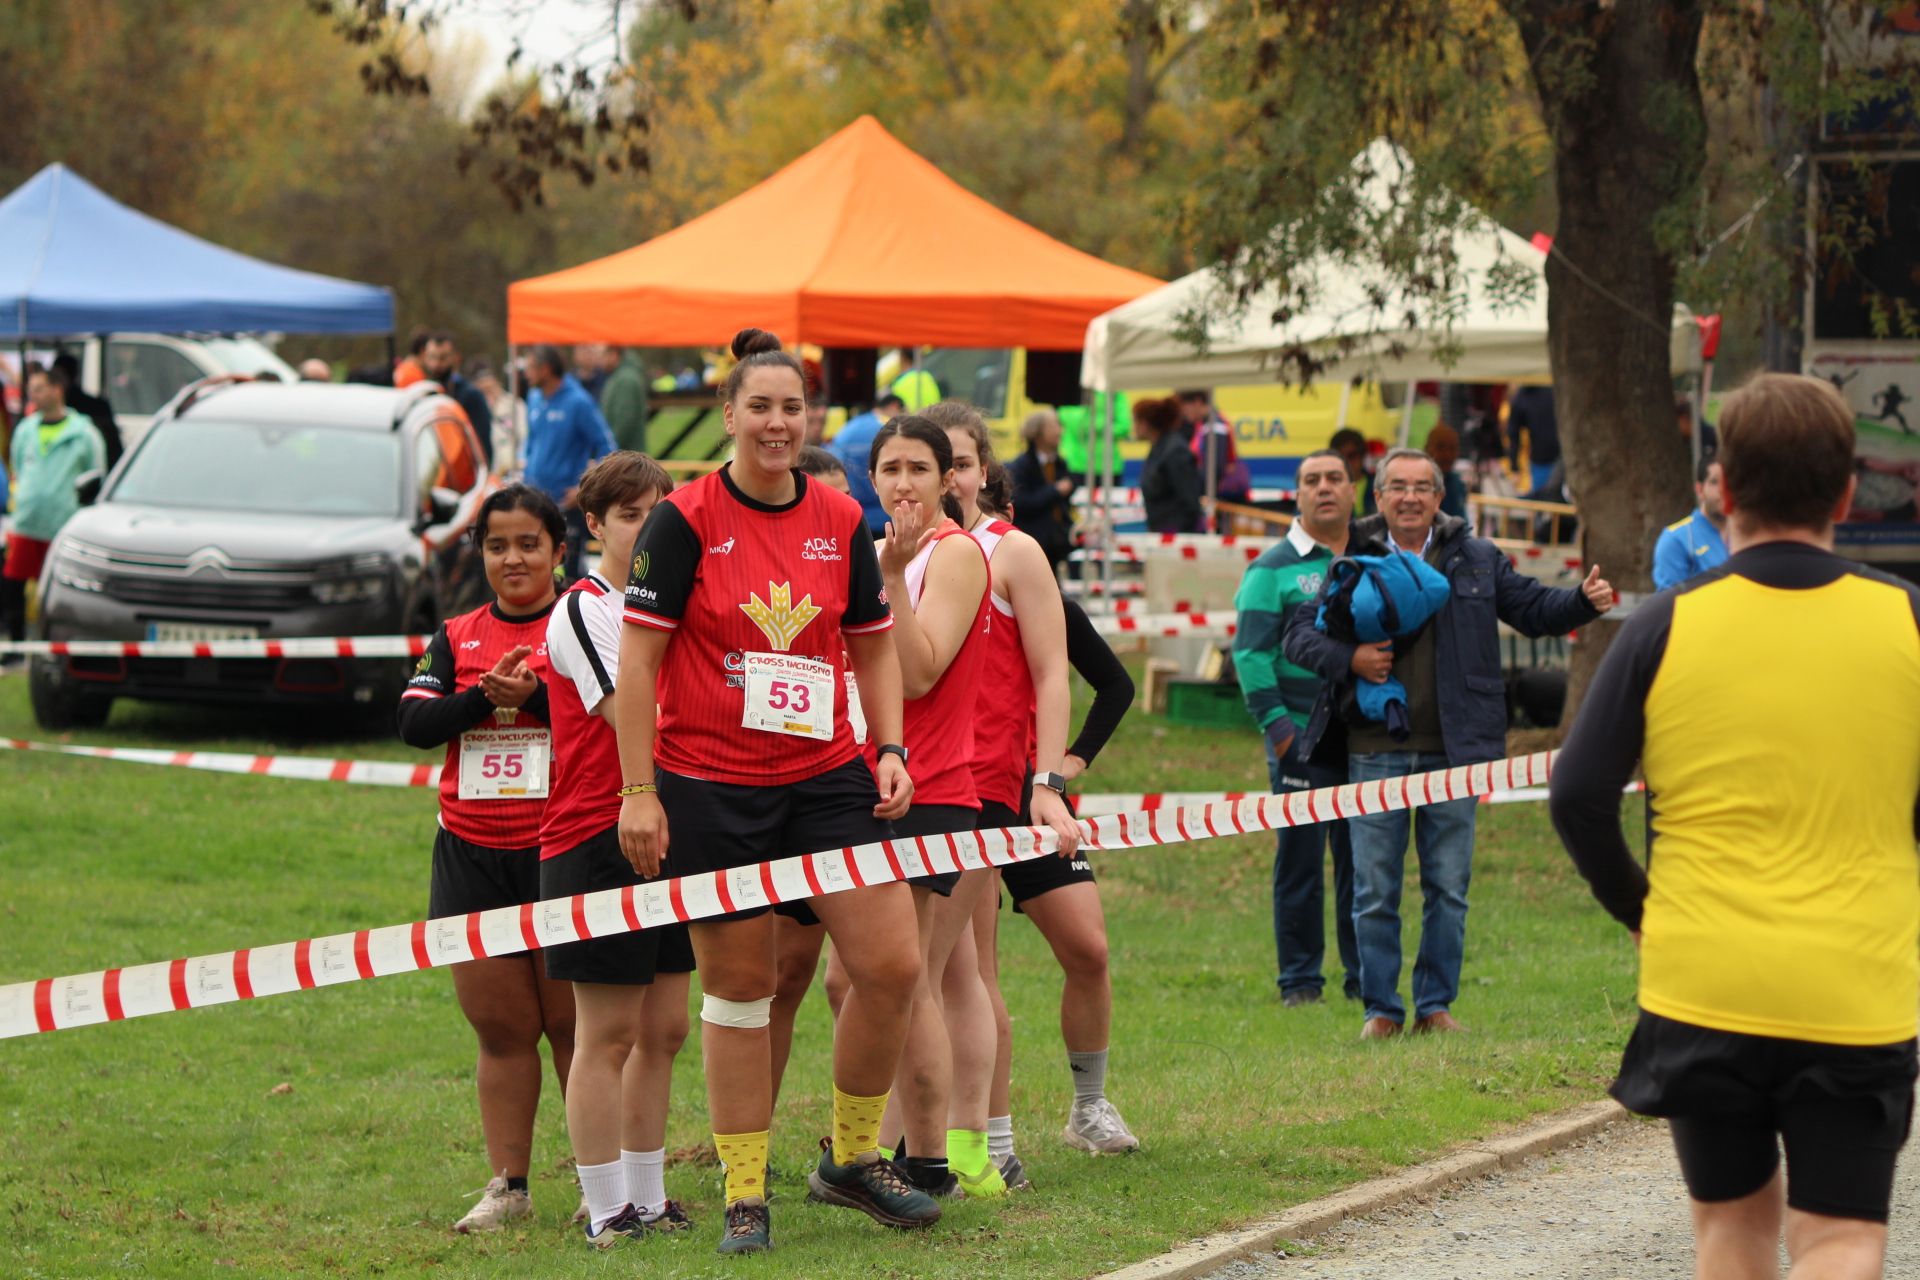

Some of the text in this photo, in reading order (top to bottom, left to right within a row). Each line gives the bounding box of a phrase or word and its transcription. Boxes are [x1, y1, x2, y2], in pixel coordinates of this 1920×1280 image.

[804, 538, 837, 552] ADAS
[801, 551, 817, 561] Club
[748, 657, 785, 668] CROSS
[786, 660, 831, 677] INCLUSIVO
[768, 681, 811, 713] 53
[464, 734, 496, 742] CROSS
[482, 754, 523, 779] 55
